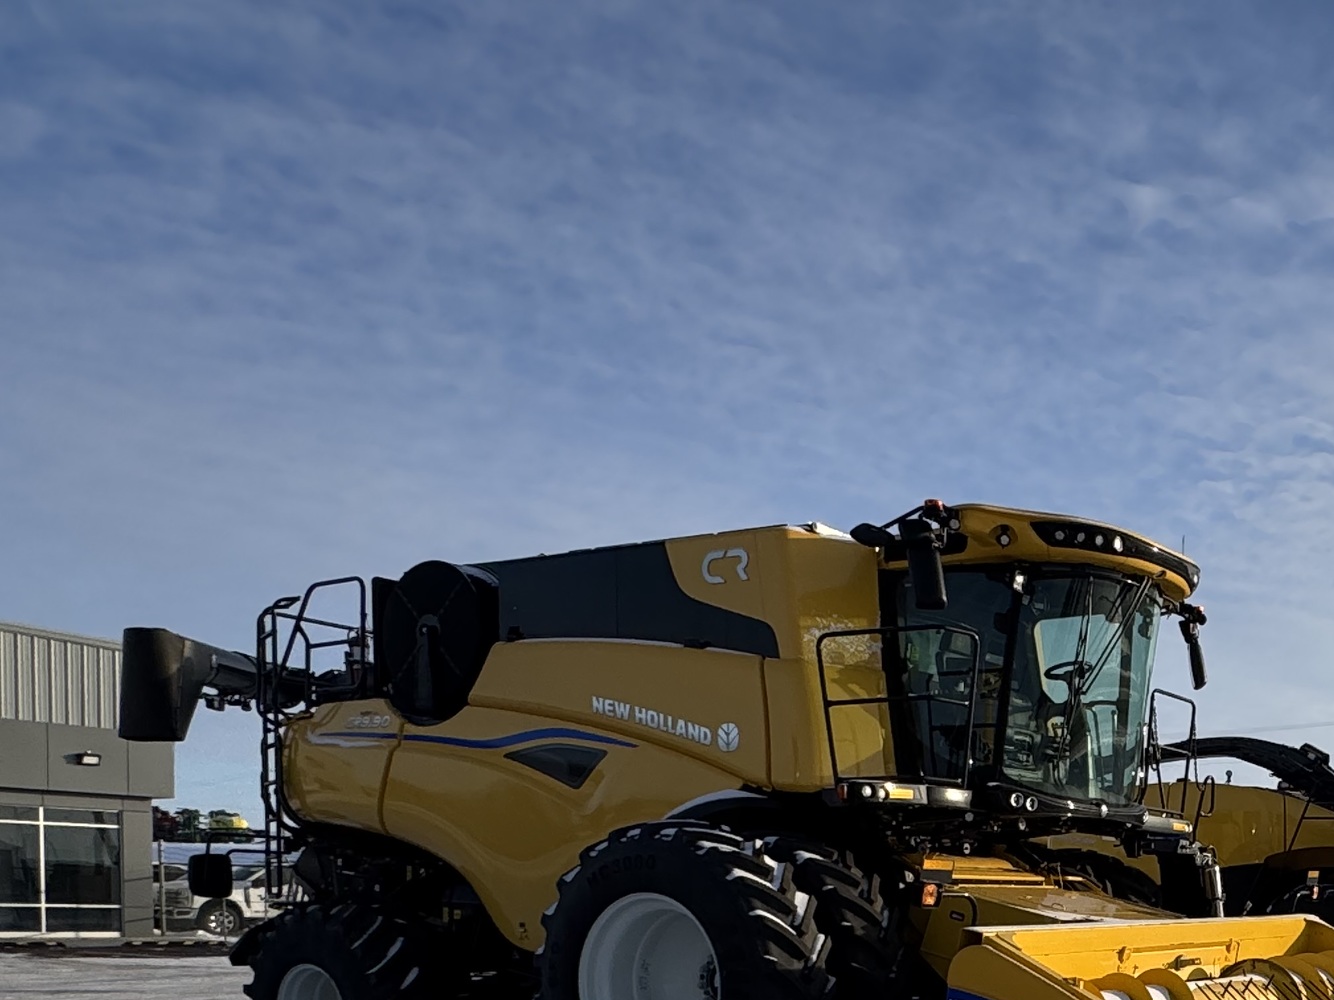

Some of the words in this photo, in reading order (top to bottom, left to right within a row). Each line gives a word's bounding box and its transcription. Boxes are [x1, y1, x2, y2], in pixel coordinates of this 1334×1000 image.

[702, 549, 748, 584] CR
[592, 696, 630, 720] NEW
[635, 706, 712, 746] HOLLAND
